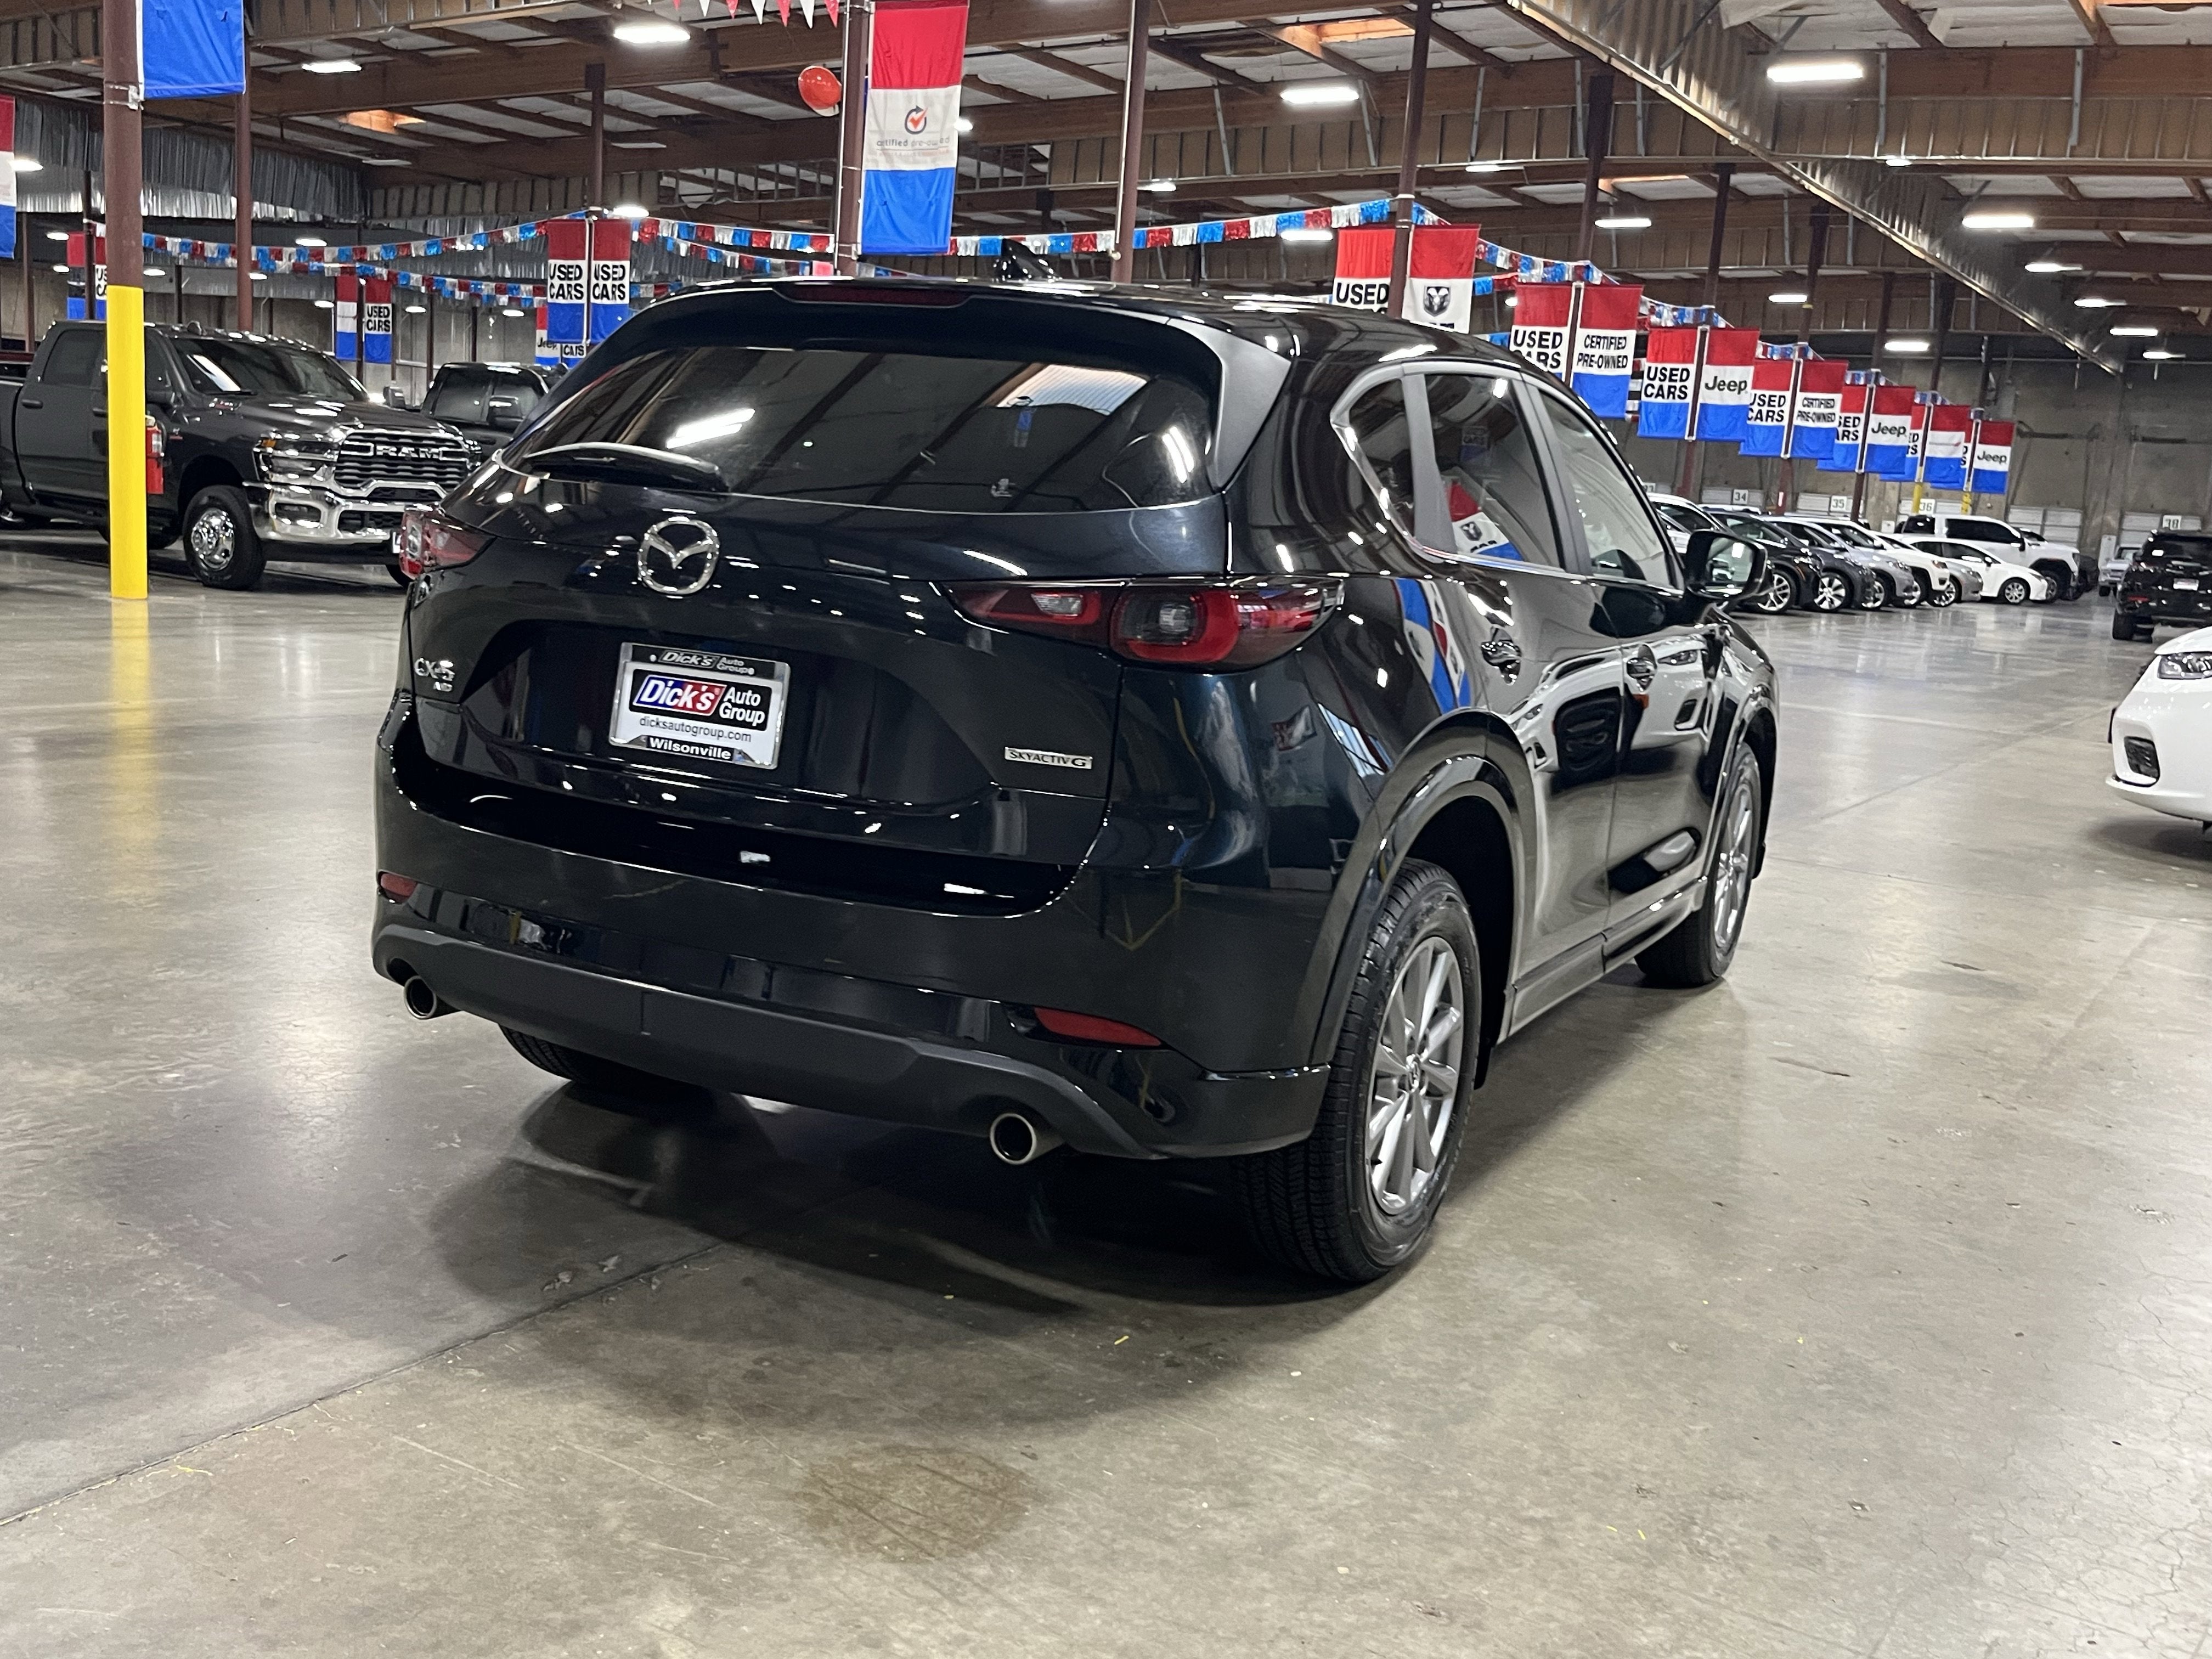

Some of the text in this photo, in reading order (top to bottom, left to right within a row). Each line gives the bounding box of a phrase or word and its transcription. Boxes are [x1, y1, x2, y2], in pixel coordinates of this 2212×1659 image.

[549, 264, 583, 281] USED
[594, 264, 625, 281] USED
[549, 283, 584, 300] CARS
[592, 283, 625, 300] CARS
[1336, 283, 1390, 305] USED
[367, 306, 390, 318] USED
[366, 319, 391, 332] CARS
[1513, 330, 1563, 349] USED
[1584, 335, 1627, 350] CERTIFIED
[1577, 353, 1628, 369] PRE-OWNED
[1646, 366, 1690, 382] USED
[1644, 383, 1688, 400] CARS
[1705, 376, 1747, 394] Jeep
[1871, 422, 1906, 437] Jeep
[376, 444, 439, 459] RAM
[1977, 451, 2007, 465] Jeep
[1734, 492, 1746, 501] 34
[1832, 499, 1845, 509] 35
[662, 652, 744, 667] Dick's Auto
[716, 663, 749, 674] Group
[640, 679, 761, 711] Dick's Auto
[719, 702, 766, 726] Group
[640, 716, 752, 742] dicksautogroup.com
[650, 737, 731, 760] Wilsonville
